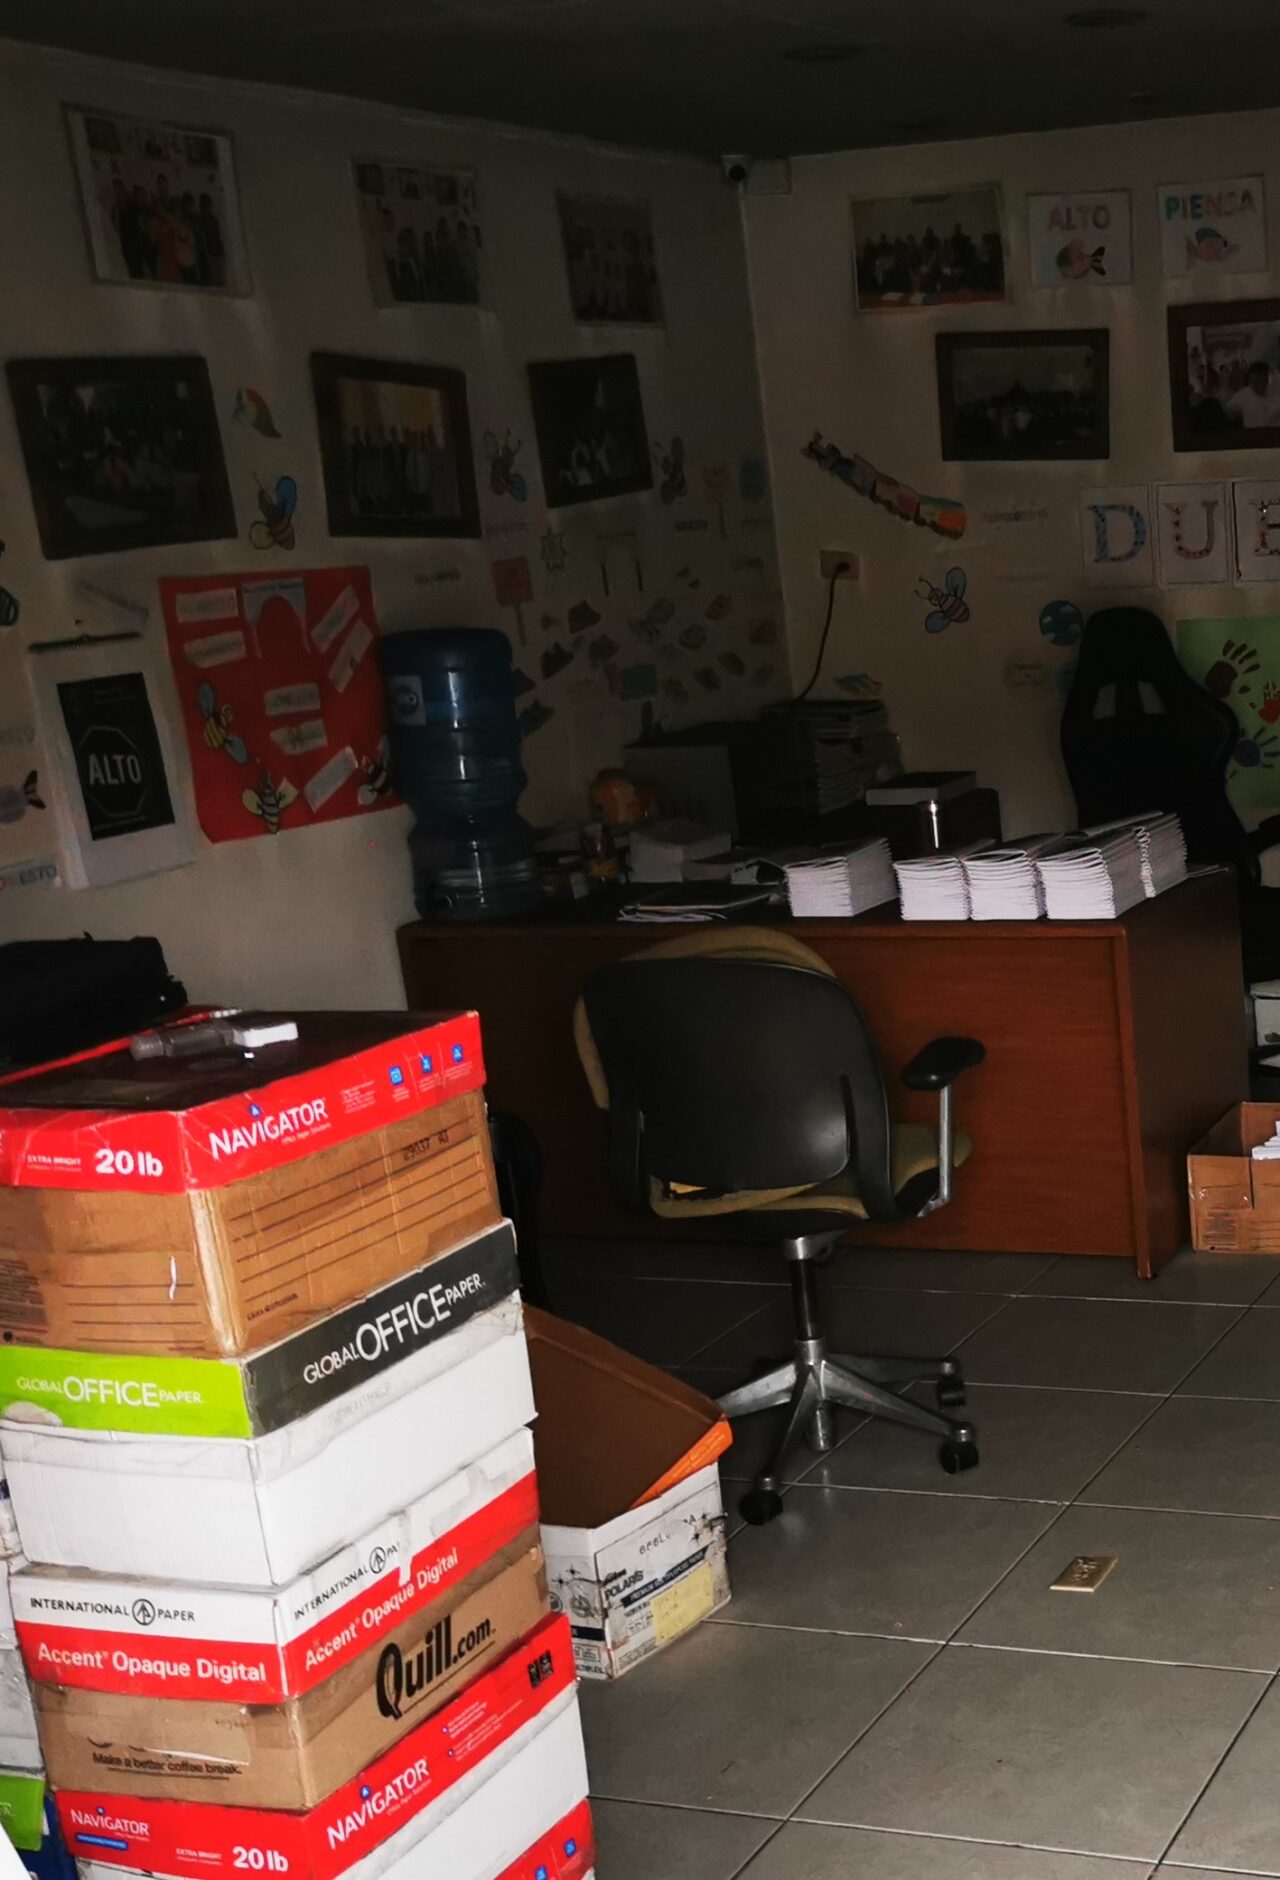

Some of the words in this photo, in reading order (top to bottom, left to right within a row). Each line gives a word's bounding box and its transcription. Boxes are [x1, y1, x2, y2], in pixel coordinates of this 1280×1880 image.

[1048, 205, 1111, 231] ALTO
[1164, 190, 1257, 220] PIENSA
[88, 753, 143, 787] ALTO
[208, 1098, 328, 1160] NAVIGATOR
[95, 1148, 135, 1175] 20
[137, 1151, 164, 1178] lb
[303, 1341, 360, 1385] GLOBAL
[355, 1283, 452, 1361] OFFICE
[444, 1273, 483, 1306] PAPER
[16, 1376, 63, 1394] GLOBAL
[63, 1376, 161, 1408] OFFICE
[159, 1389, 203, 1405] PAPER
[294, 1566, 369, 1621] INTERNATIONAL
[361, 1582, 415, 1630] Opaque
[416, 1546, 459, 1590] Digital
[30, 1597, 130, 1618] INTERNATIONAL
[158, 1608, 196, 1622] PAPER
[112, 1650, 192, 1680] Opaque
[196, 1658, 267, 1685] Digital
[376, 1613, 492, 1721] Quill.com
[93, 1751, 122, 1767] Make
[124, 1757, 132, 1767] a
[133, 1757, 165, 1770] better
[167, 1758, 203, 1774] coffee
[327, 1758, 430, 1850] NAVIGATOR
[69, 1808, 150, 1836] NAVIGATOR
[232, 1845, 264, 1870] 20
[266, 1849, 289, 1873] lb
